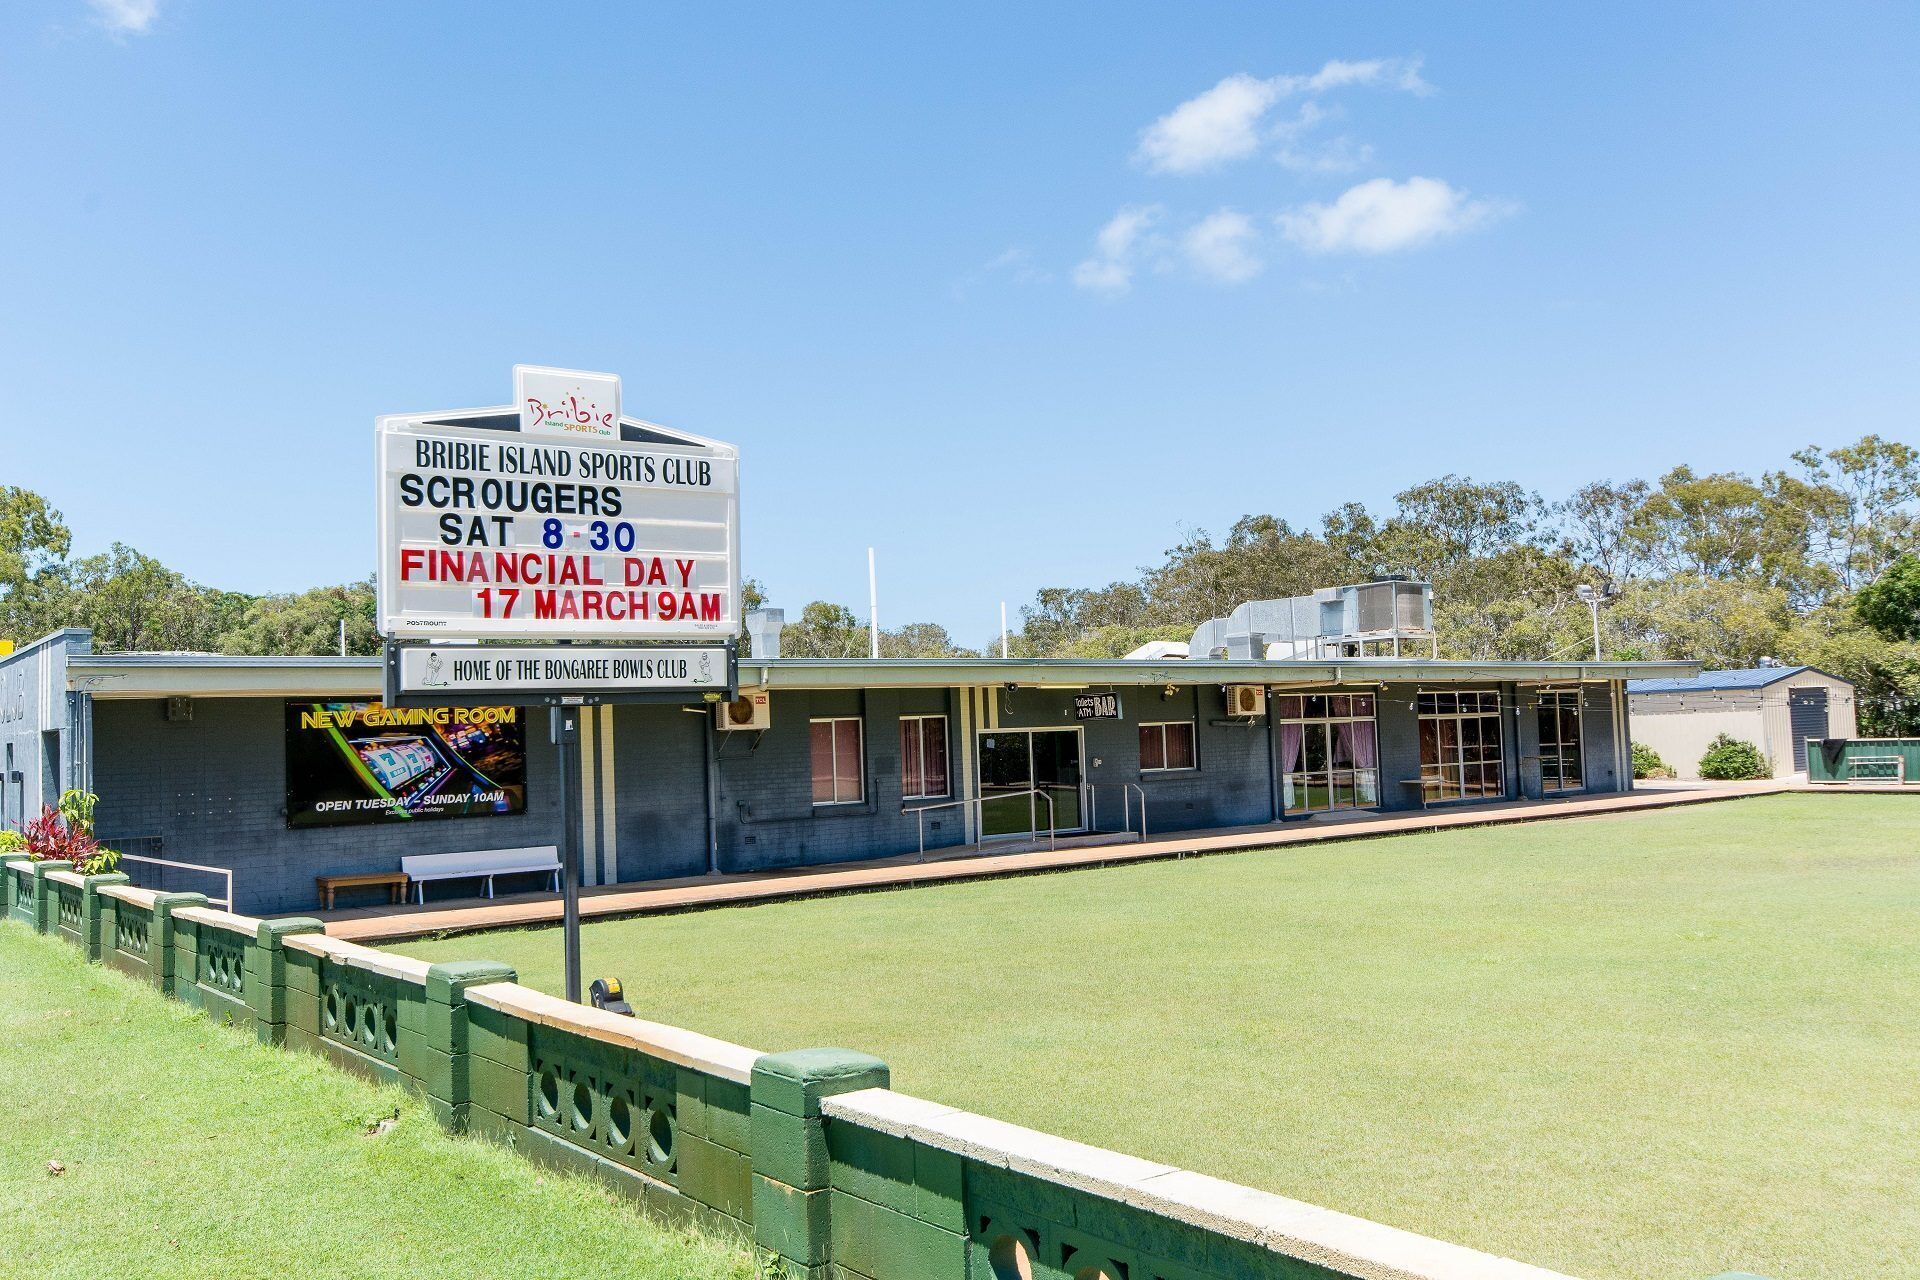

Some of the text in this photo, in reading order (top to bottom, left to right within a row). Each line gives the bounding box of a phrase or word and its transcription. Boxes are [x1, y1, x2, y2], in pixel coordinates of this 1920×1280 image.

[528, 396, 613, 428] Bribie
[564, 423, 598, 434] SPORTS
[416, 439, 712, 486] BRIBIE ISLAND SPORTS CLUB
[400, 473, 622, 517] SCROUGERS
[439, 512, 514, 547] SAT
[401, 549, 695, 588] FINANCIAL DAY
[477, 587, 721, 622] 17 MARCH 9AM
[454, 659, 687, 681] HOME OF THE BONGAREE BOWLS CLUB
[301, 707, 516, 729] NEW GAMING ROOM
[1094, 696, 1117, 717] BAR
[315, 801, 352, 812] OPEN
[355, 796, 412, 809] TUESDAY
[423, 793, 470, 805] SUNDAY
[473, 791, 505, 803] 10AM
